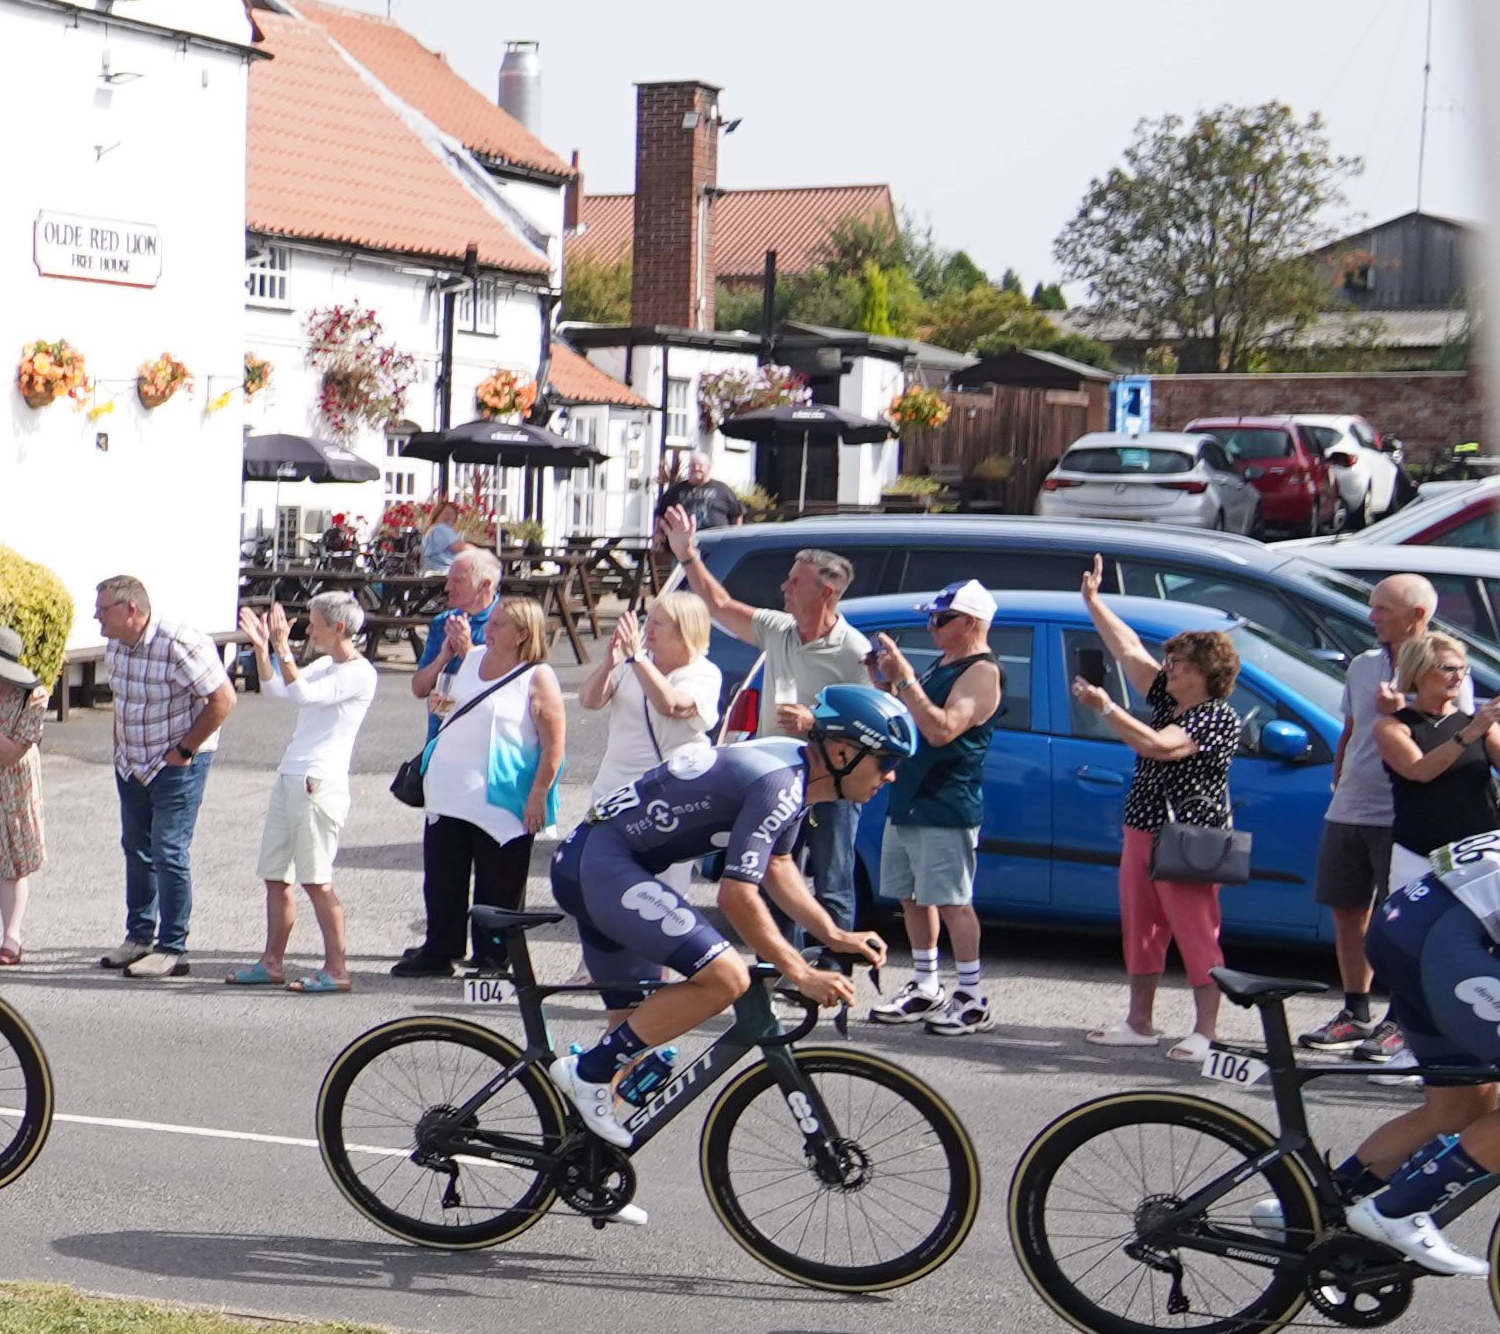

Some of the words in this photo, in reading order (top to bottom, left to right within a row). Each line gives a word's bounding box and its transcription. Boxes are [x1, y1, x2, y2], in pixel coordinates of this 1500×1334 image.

[44, 221, 83, 248] OLDE
[90, 227, 120, 252] RED
[126, 232, 157, 257] LION
[71, 253, 93, 269] FREE
[99, 256, 131, 274] HOUSE
[467, 980, 504, 1004] 104
[1210, 1052, 1249, 1084] 106
[628, 1045, 719, 1135] SCOTT
[1226, 1246, 1281, 1266] SHIMANO
